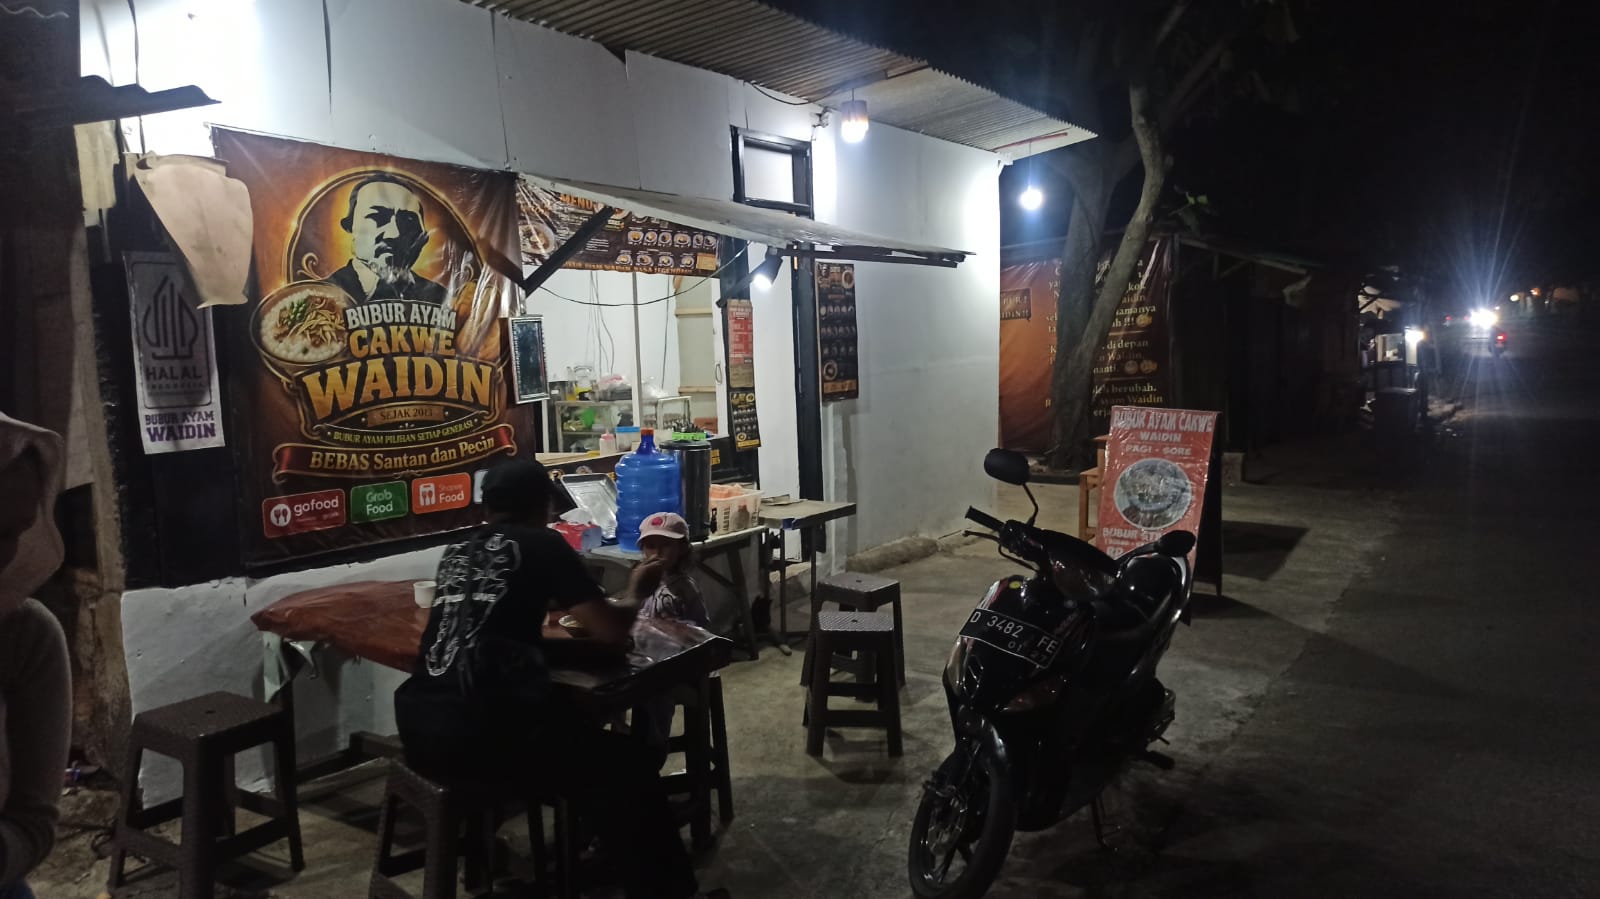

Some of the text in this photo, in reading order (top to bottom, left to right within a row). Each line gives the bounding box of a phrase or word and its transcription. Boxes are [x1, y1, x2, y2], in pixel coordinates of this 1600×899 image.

[346, 302, 457, 330] BUBUR AYAM
[350, 325, 456, 358] CAKWE
[146, 365, 203, 380] HALAL
[303, 356, 492, 419] WAIDIN
[145, 411, 214, 425] BUBUR AYAM
[381, 408, 410, 419] SEJAK
[1113, 410, 1212, 432] BUBUR AYAM CAKWE
[147, 423, 216, 442] WAIDIN
[332, 431, 361, 443] BUBUR
[363, 435, 383, 444] AYAM
[442, 421, 473, 437] GENERASI
[1139, 431, 1182, 442] WAIDIN
[310, 435, 495, 471] BEBAS Santan dan Pecin
[365, 489, 392, 502] Grab
[439, 491, 465, 504] Food
[294, 496, 339, 517] gofood
[366, 503, 394, 516] Food
[970, 611, 1058, 654] D 3482 FE
